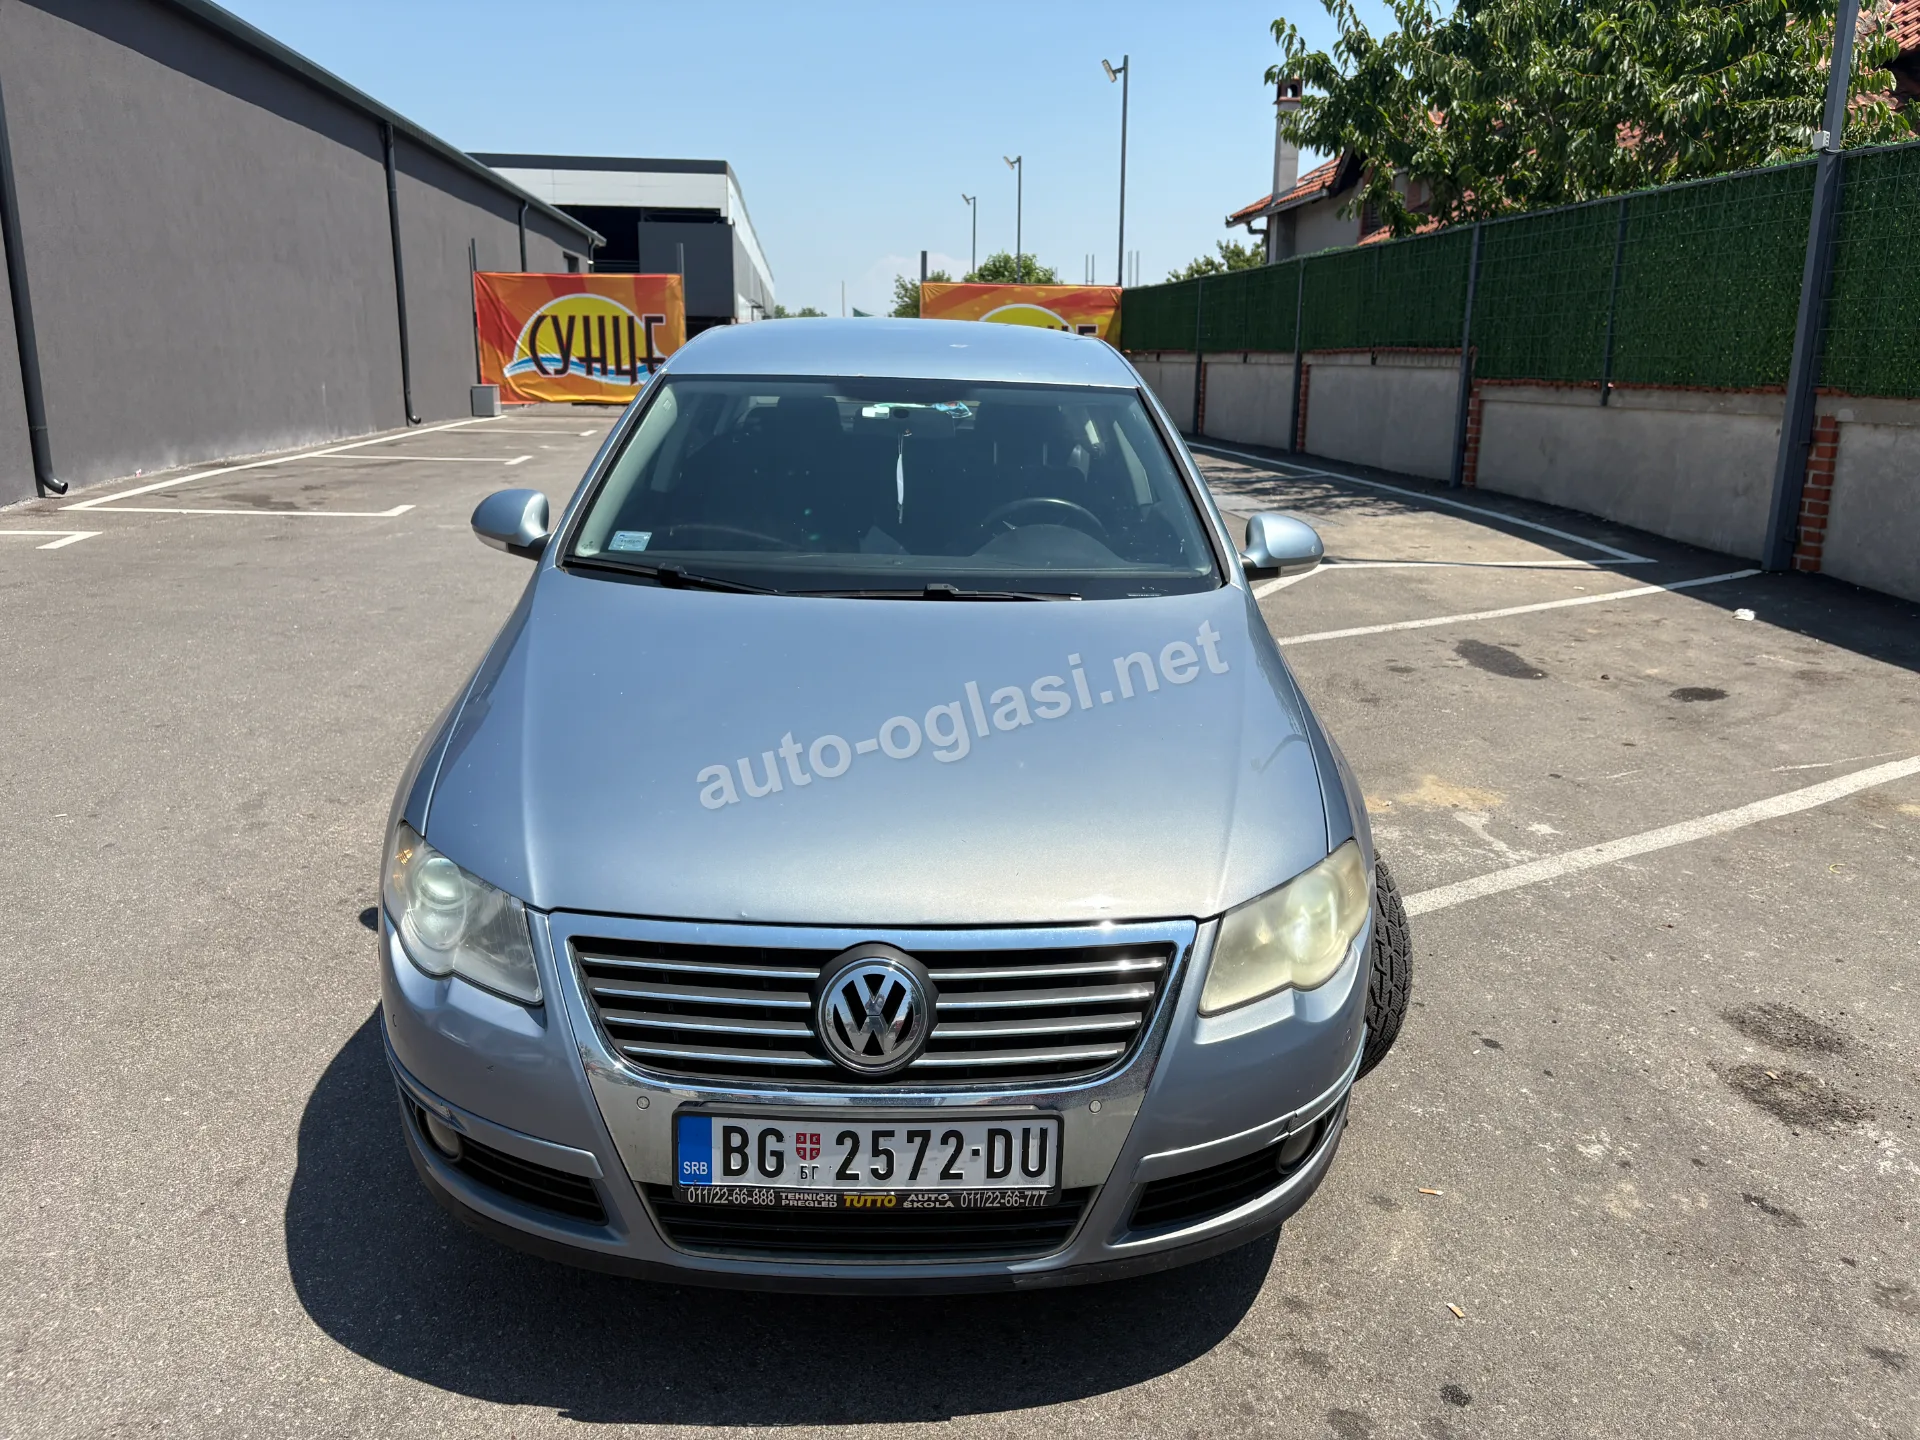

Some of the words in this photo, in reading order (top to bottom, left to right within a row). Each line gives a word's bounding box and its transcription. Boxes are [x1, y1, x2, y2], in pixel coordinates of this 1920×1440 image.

[528, 314, 667, 385] СУНЦЕ
[722, 1125, 785, 1178] BG
[683, 1161, 708, 1175] SRB
[687, 1186, 775, 1206] 011/22-66-888
[843, 1195, 897, 1208] TUTTO
[908, 1193, 950, 1201] AUTO
[960, 1190, 1047, 1207] 011/22-66-777
[781, 1200, 838, 1208] PREGLED
[903, 1200, 955, 1208] ŠKOLA
